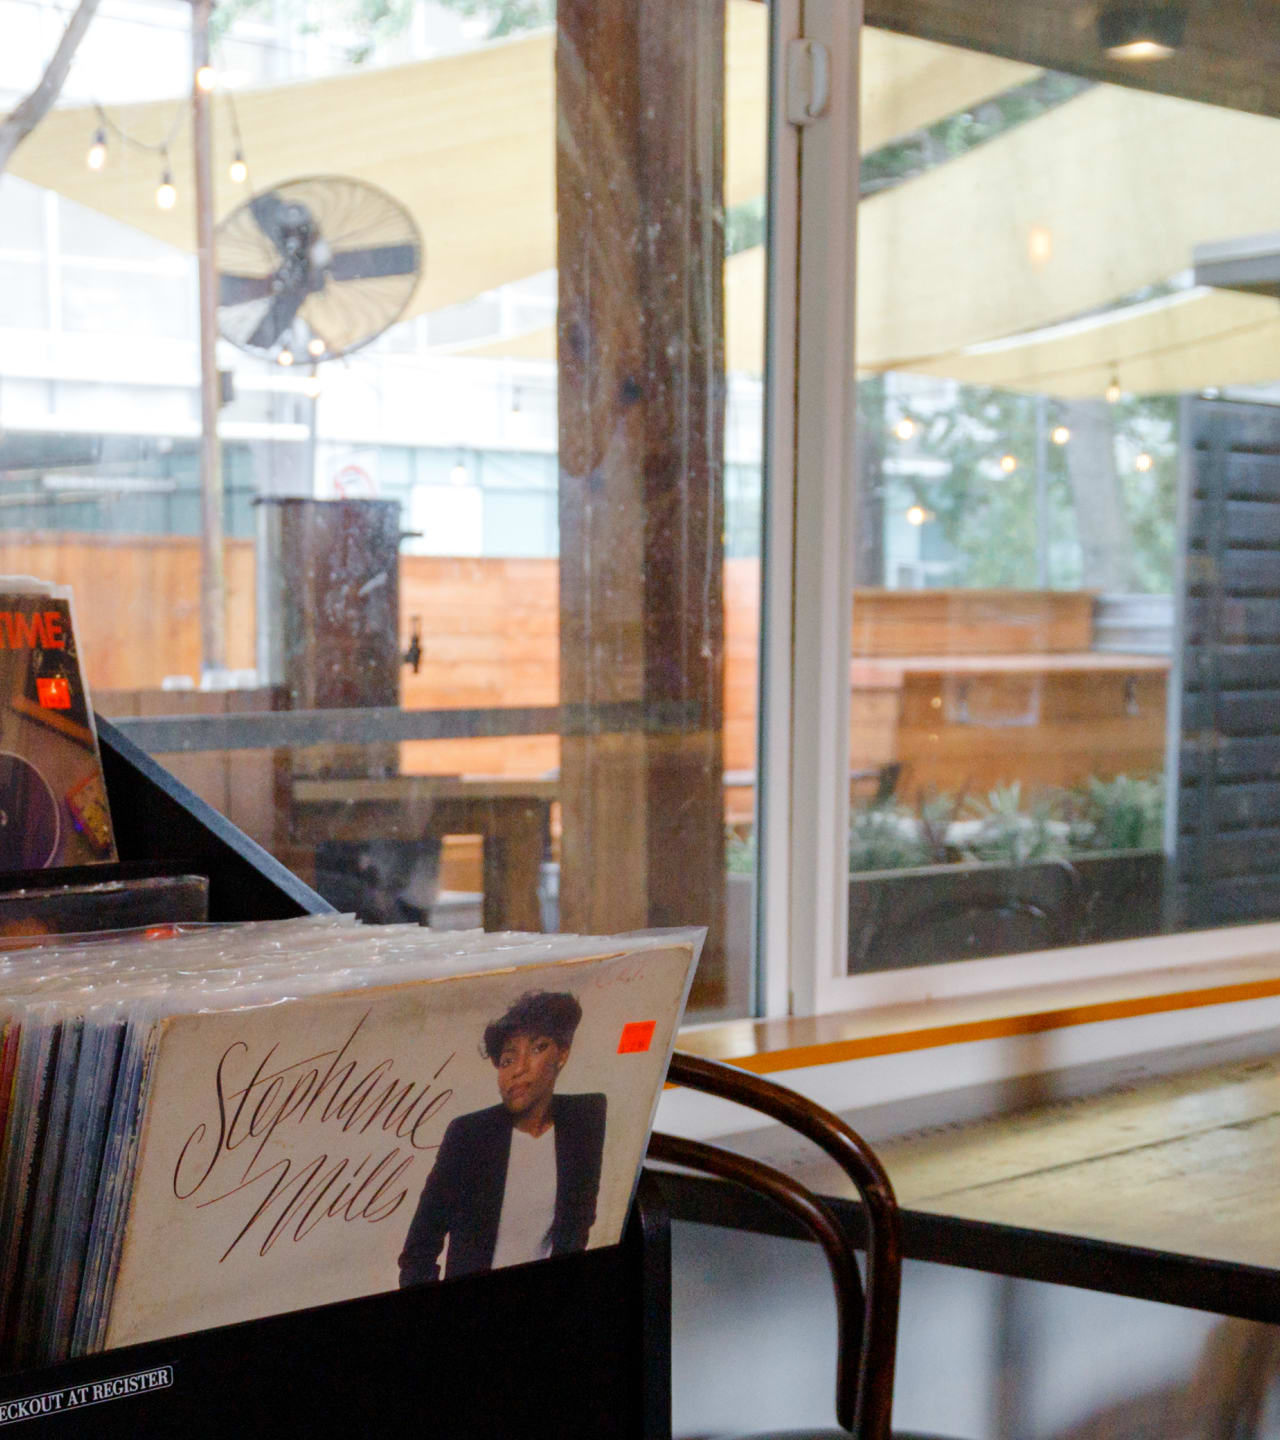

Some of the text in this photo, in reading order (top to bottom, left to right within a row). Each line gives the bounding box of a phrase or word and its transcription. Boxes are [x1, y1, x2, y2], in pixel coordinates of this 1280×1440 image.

[173, 1007, 456, 1201] Stephanie
[196, 1146, 416, 1264] Mills
[67, 1388, 89, 1407] AT
[92, 1369, 170, 1400] REGISTER
